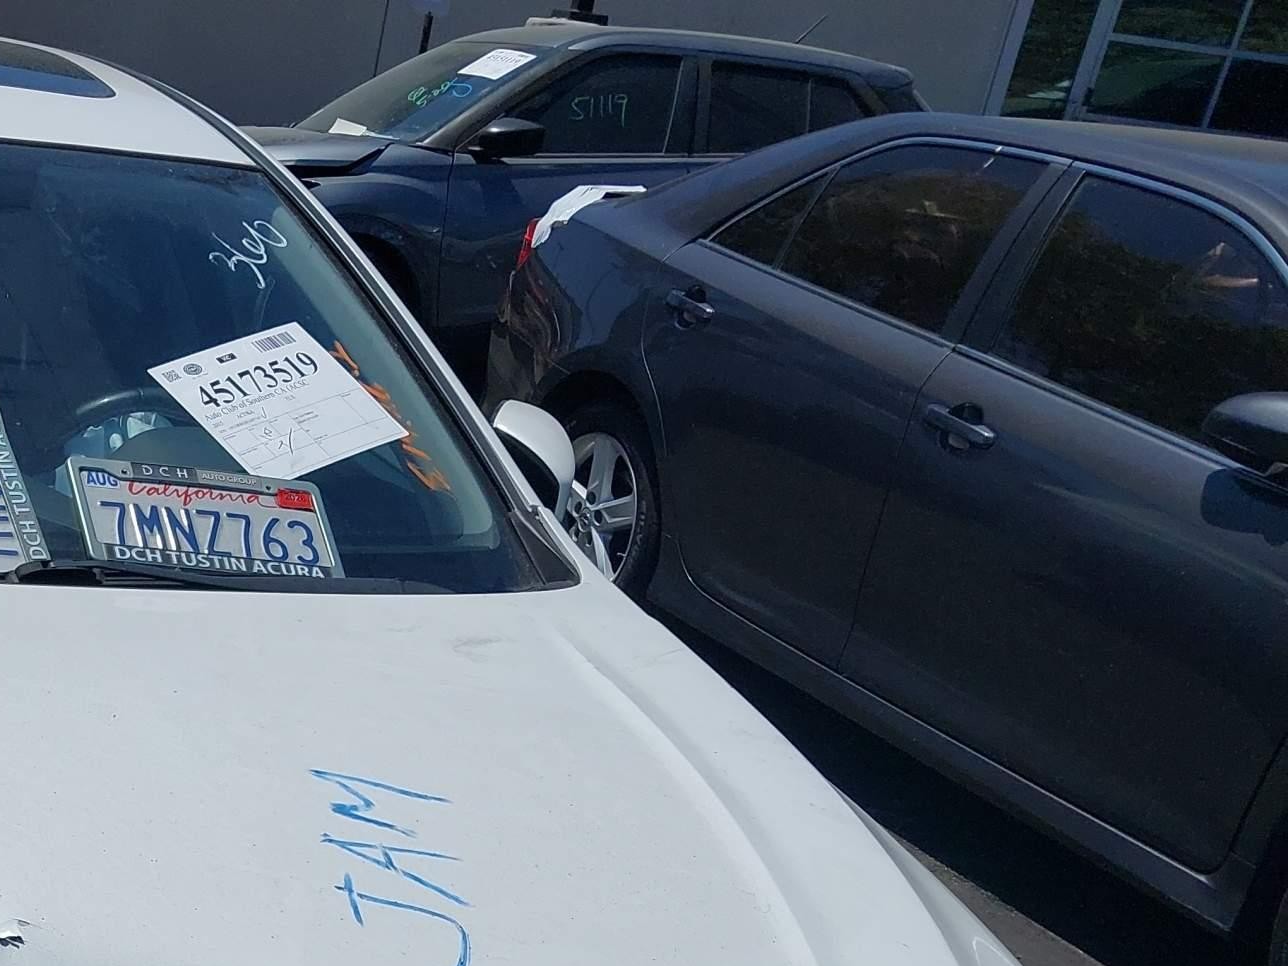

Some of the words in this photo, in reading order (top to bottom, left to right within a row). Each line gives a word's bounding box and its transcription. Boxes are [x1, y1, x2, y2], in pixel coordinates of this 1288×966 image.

[570, 94, 629, 127] 51119
[198, 352, 319, 409] 45173519
[205, 410, 222, 421] Auto
[221, 404, 239, 416] Club
[239, 400, 247, 409] of
[246, 391, 274, 407] Southern
[86, 471, 119, 487] AUG
[128, 481, 274, 507] California
[19, 520, 48, 560] DCH
[97, 500, 320, 565] 7MNZ763
[115, 546, 162, 563] DCH
[166, 551, 246, 572] TUSTIN
[253, 558, 325, 579] ACURA
